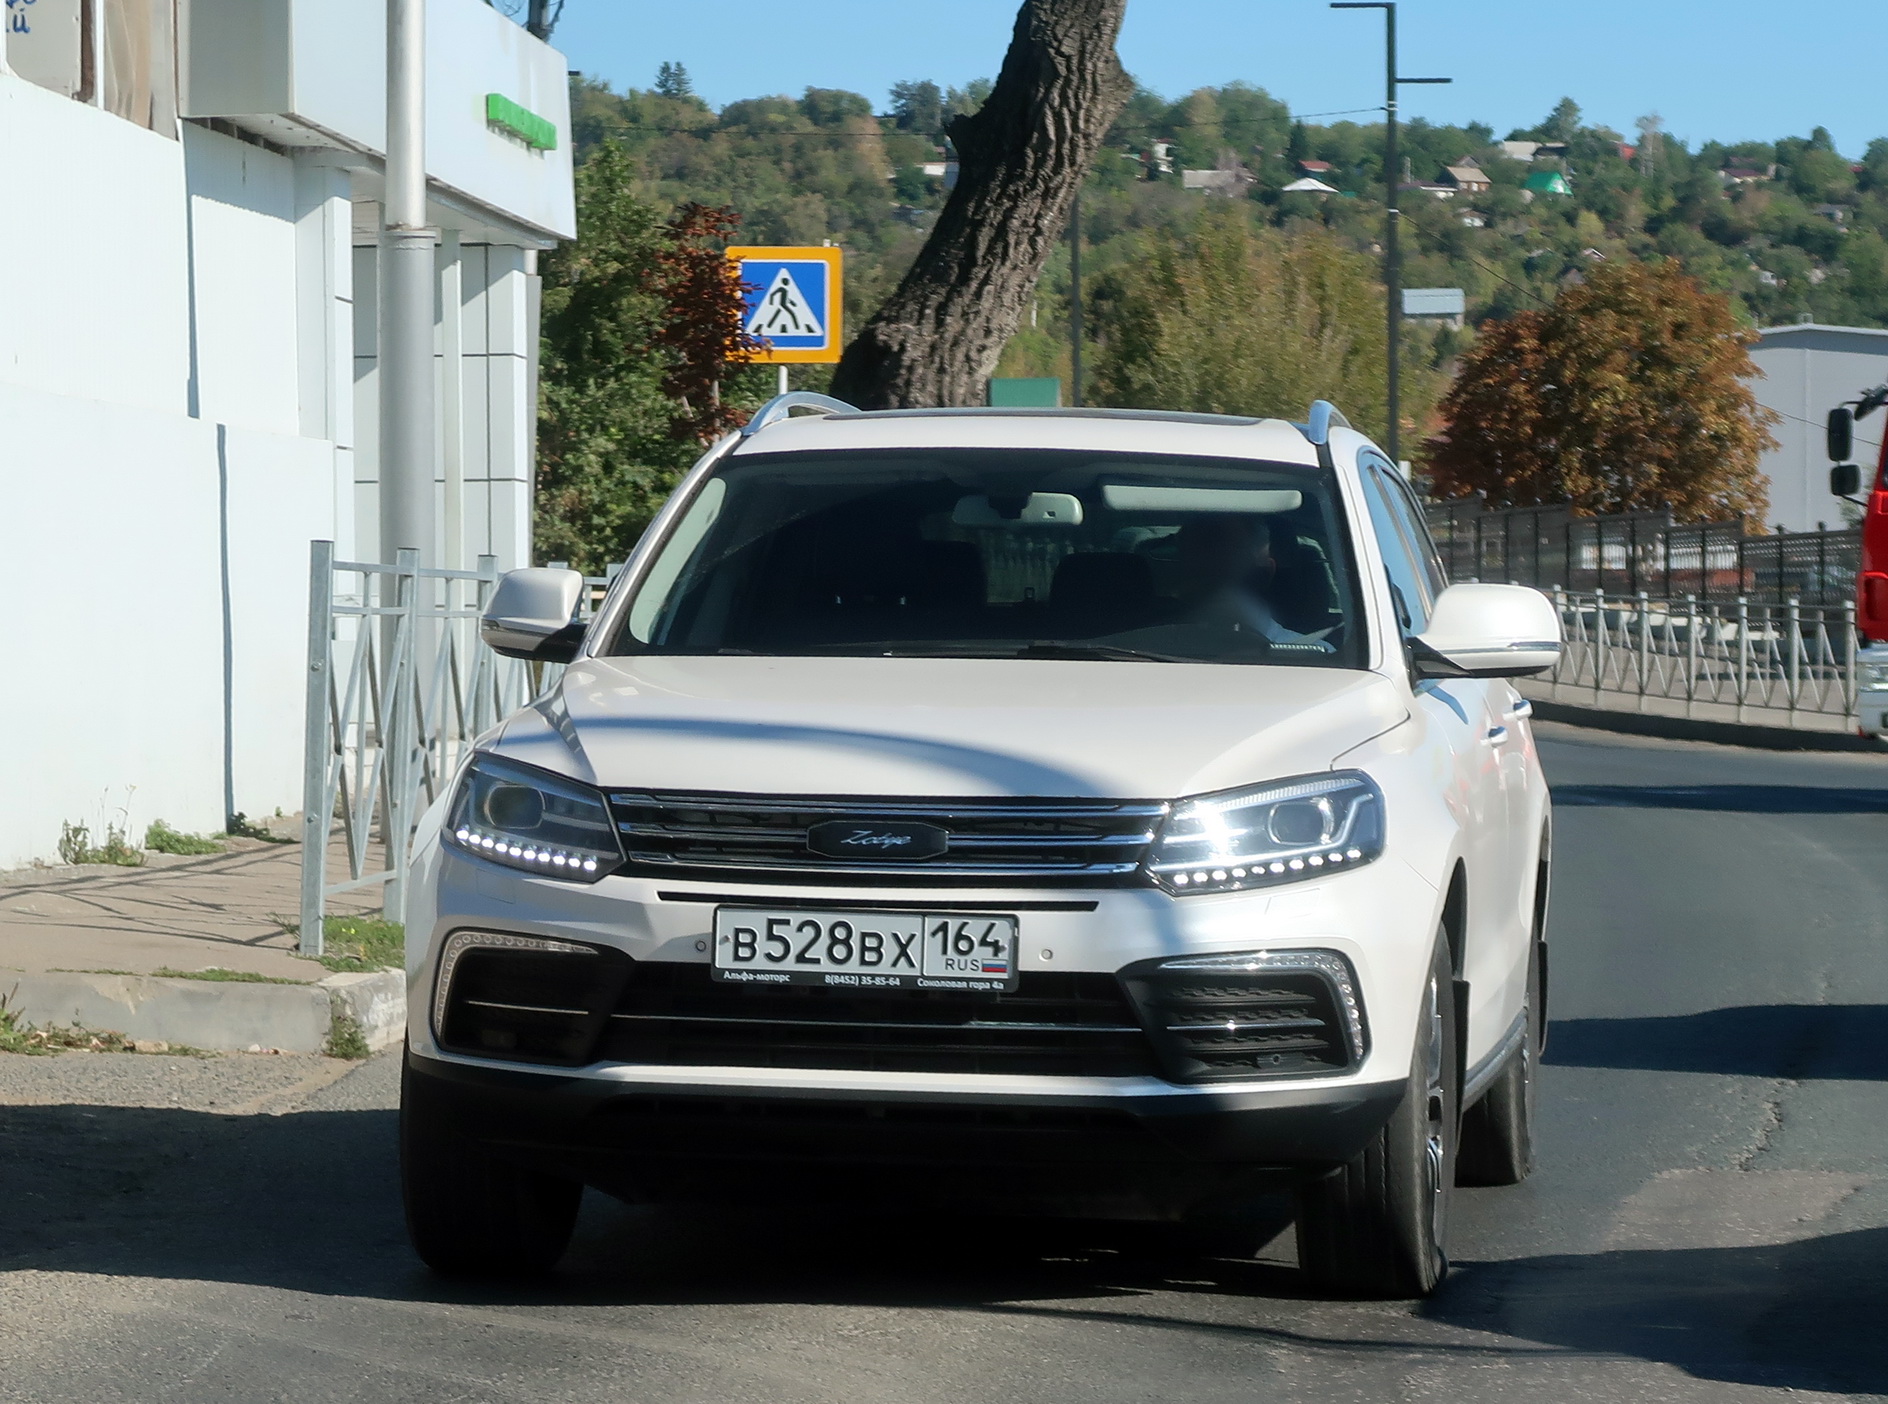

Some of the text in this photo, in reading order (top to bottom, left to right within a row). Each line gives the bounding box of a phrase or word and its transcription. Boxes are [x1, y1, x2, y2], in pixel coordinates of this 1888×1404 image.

[732, 917, 918, 968] В528ВХ
[930, 920, 1000, 957] 164
[945, 958, 980, 972] RUS
[723, 970, 791, 983] Альфа-моторс
[824, 974, 859, 986] 8(8452)
